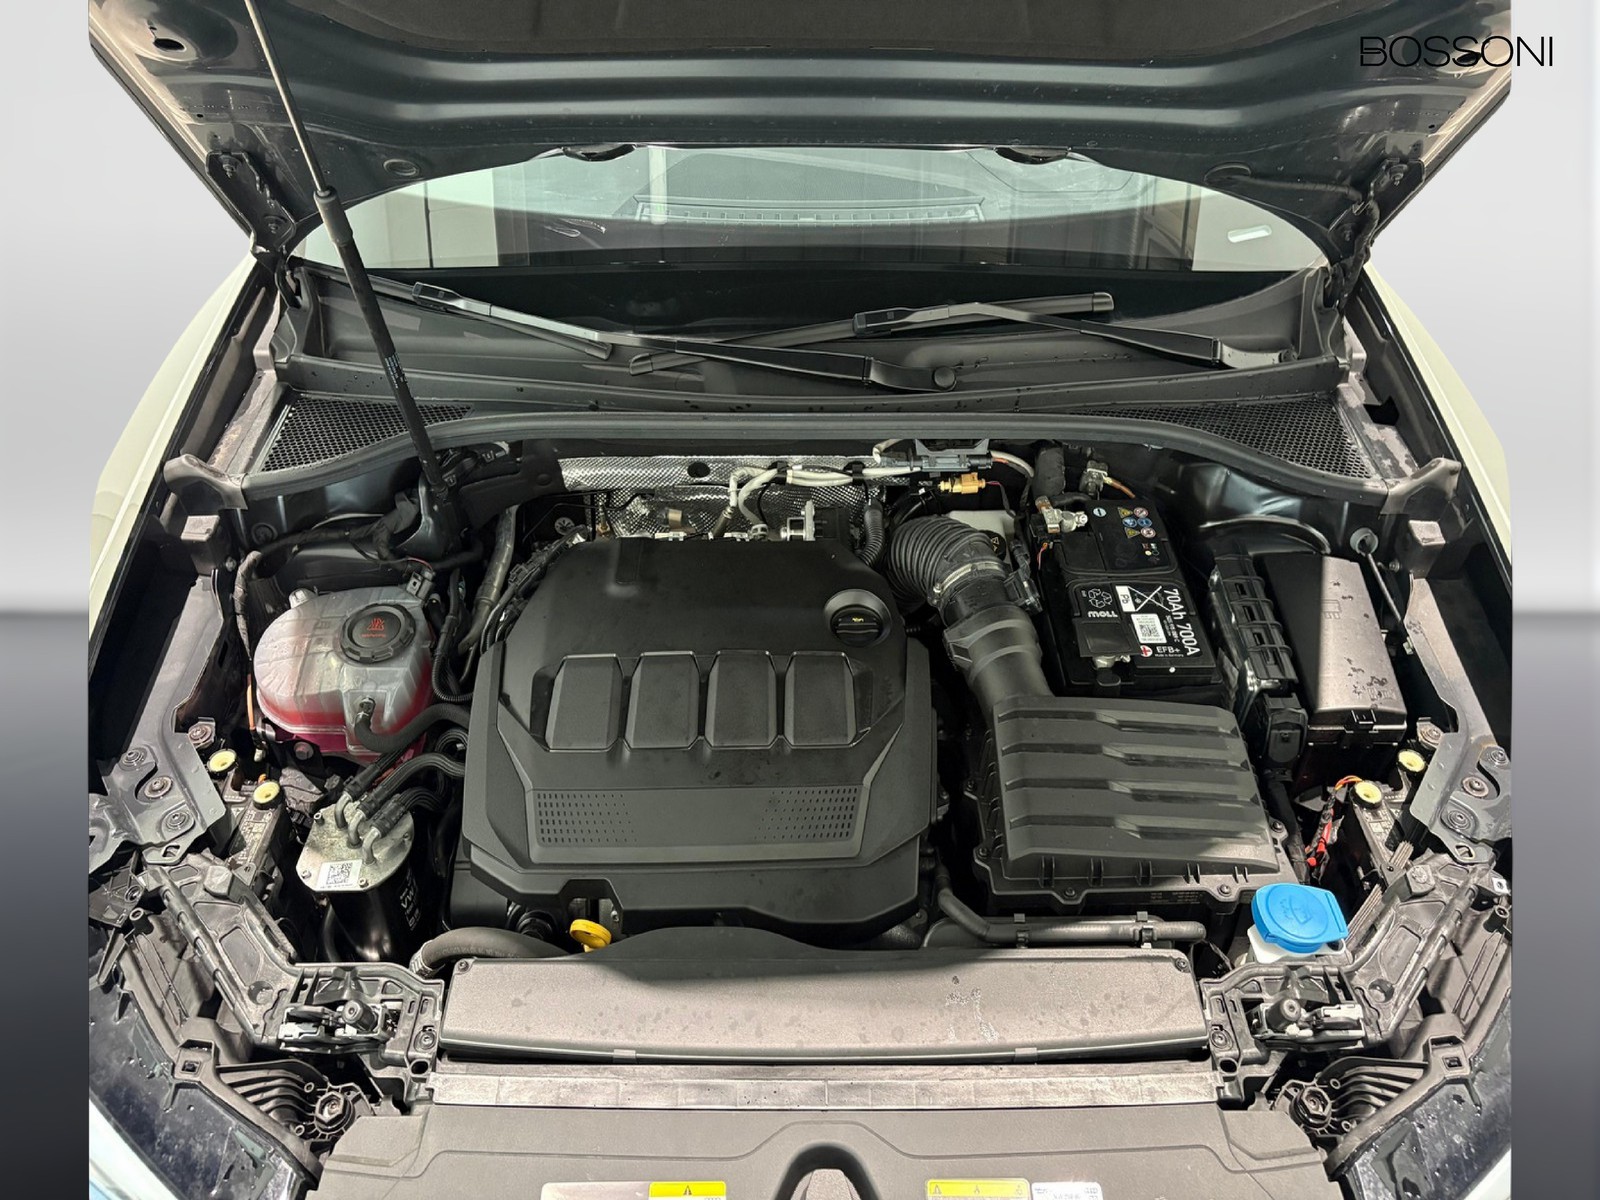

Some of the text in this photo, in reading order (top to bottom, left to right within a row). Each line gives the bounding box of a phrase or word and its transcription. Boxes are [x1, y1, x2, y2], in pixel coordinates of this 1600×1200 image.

[1120, 594, 1131, 604] Pb
[1164, 588, 1187, 620] 70Ah
[1176, 623, 1201, 656] 700A
[1156, 646, 1180, 654] EFB+
